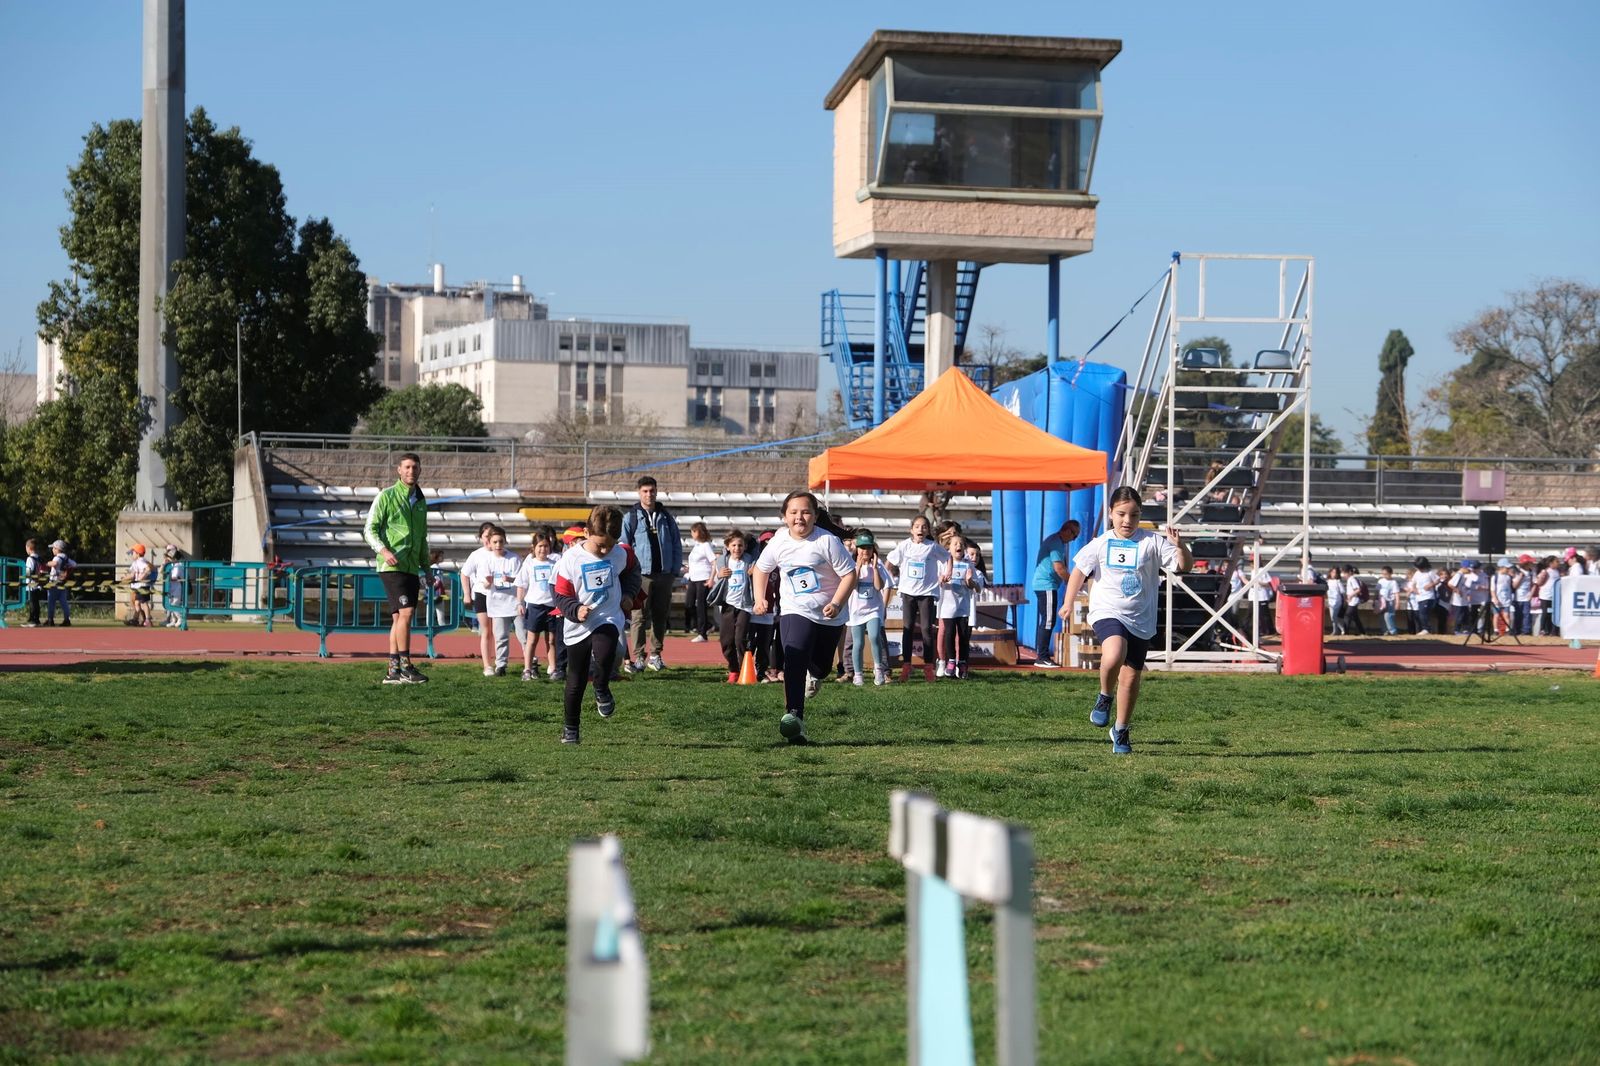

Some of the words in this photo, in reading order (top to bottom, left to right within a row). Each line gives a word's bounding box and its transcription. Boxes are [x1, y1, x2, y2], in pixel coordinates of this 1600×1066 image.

[1118, 554, 1126, 563] 3
[595, 576, 603, 586] 3
[800, 580, 808, 588] 3
[1573, 592, 1600, 610] EM
